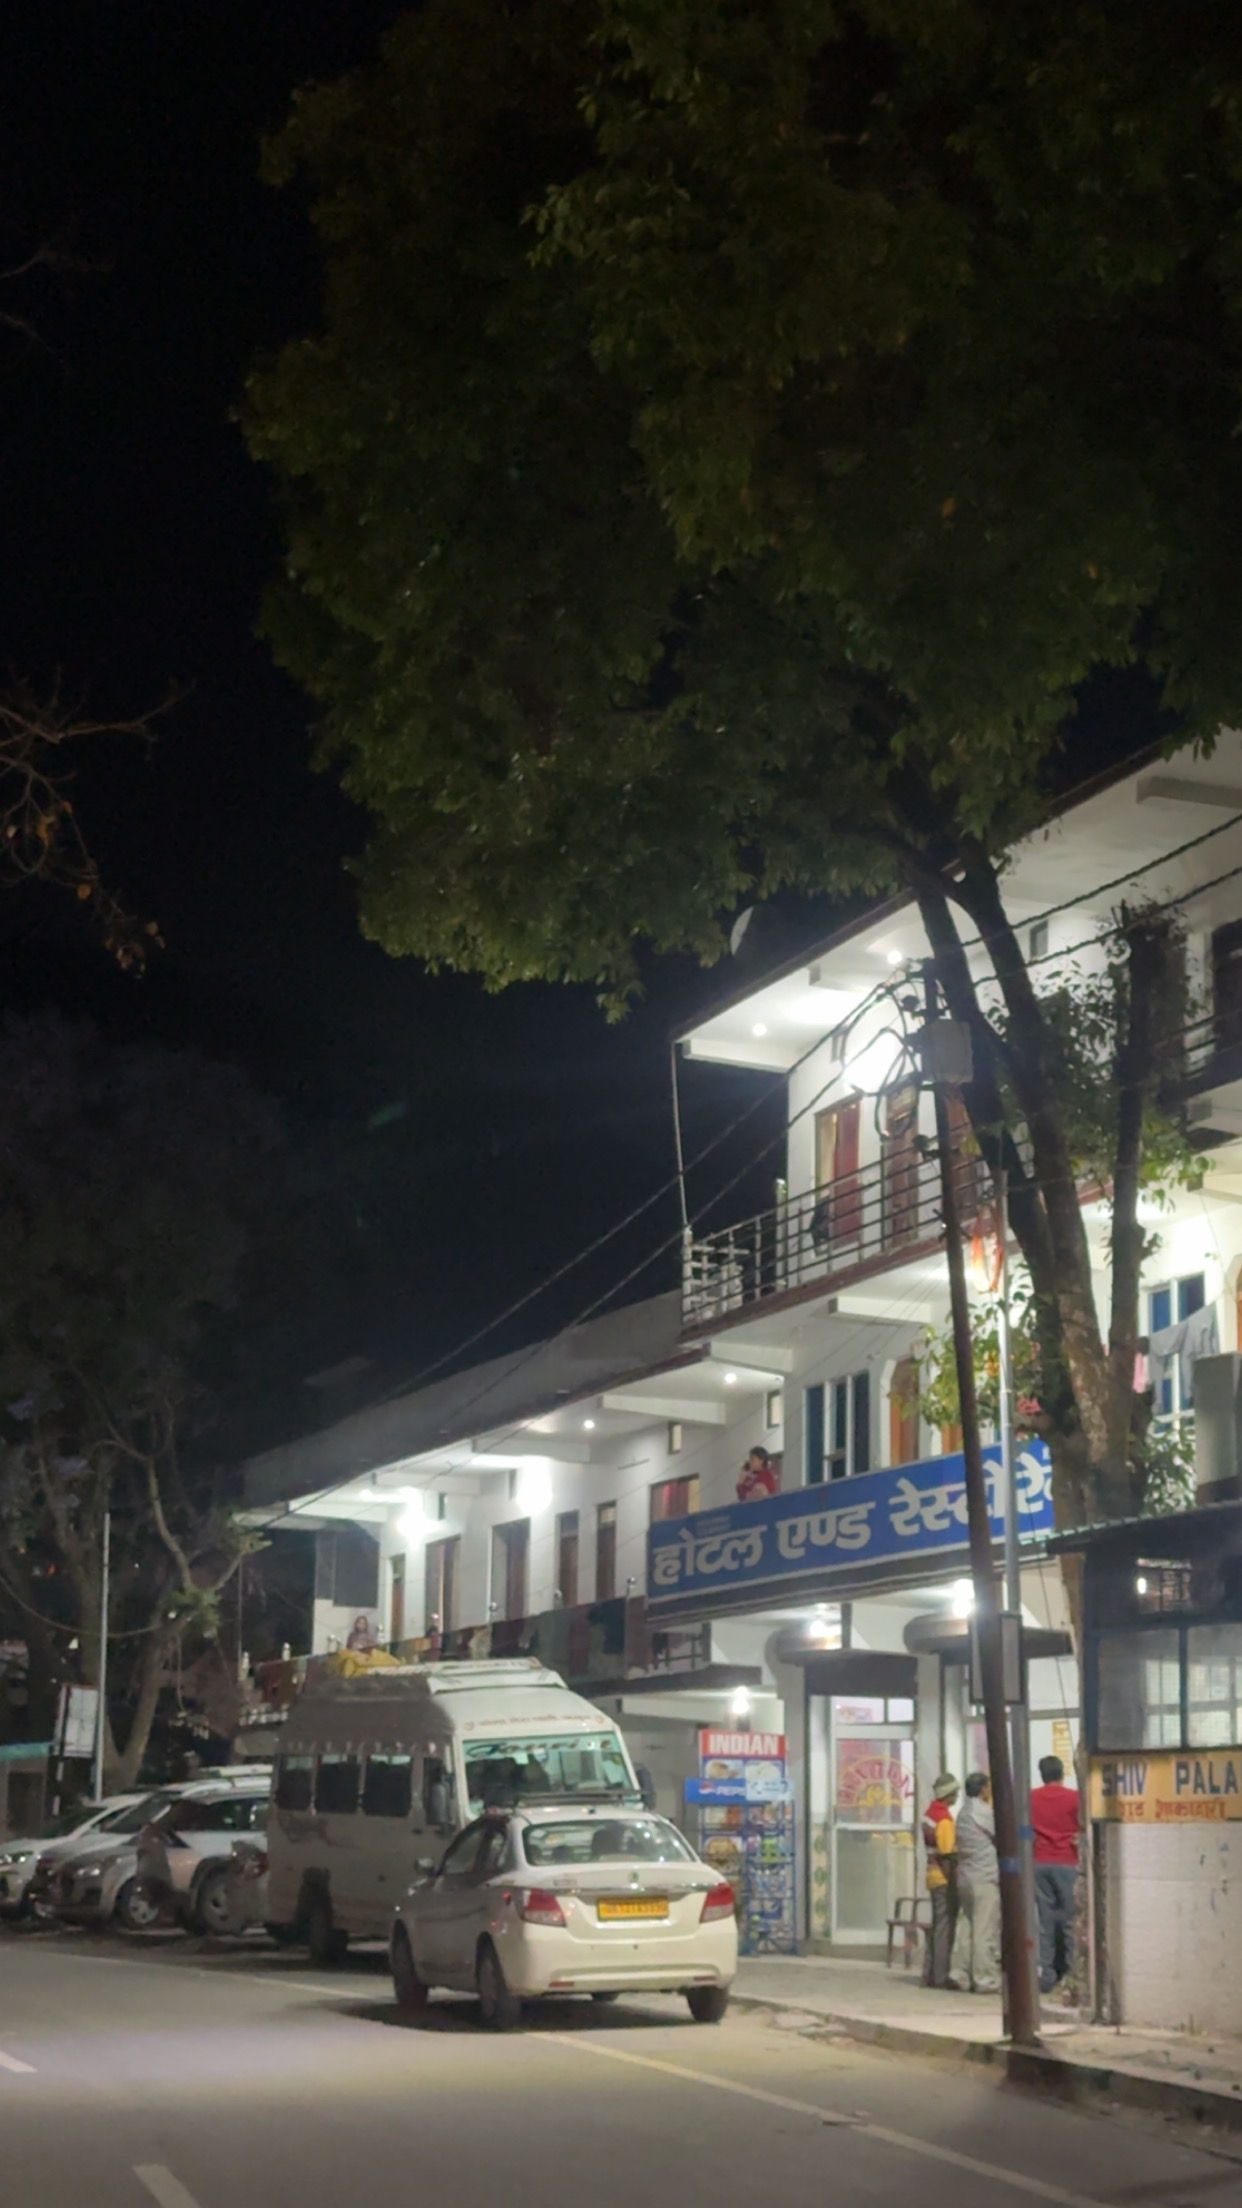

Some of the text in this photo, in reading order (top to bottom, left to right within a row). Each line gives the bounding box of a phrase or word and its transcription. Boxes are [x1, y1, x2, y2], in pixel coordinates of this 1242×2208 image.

[653, 1526, 768, 1586] होटल
[776, 1501, 876, 1560] एण्ड
[709, 1733, 779, 1756] INDIAN
[1101, 1761, 1148, 1797] SHIV
